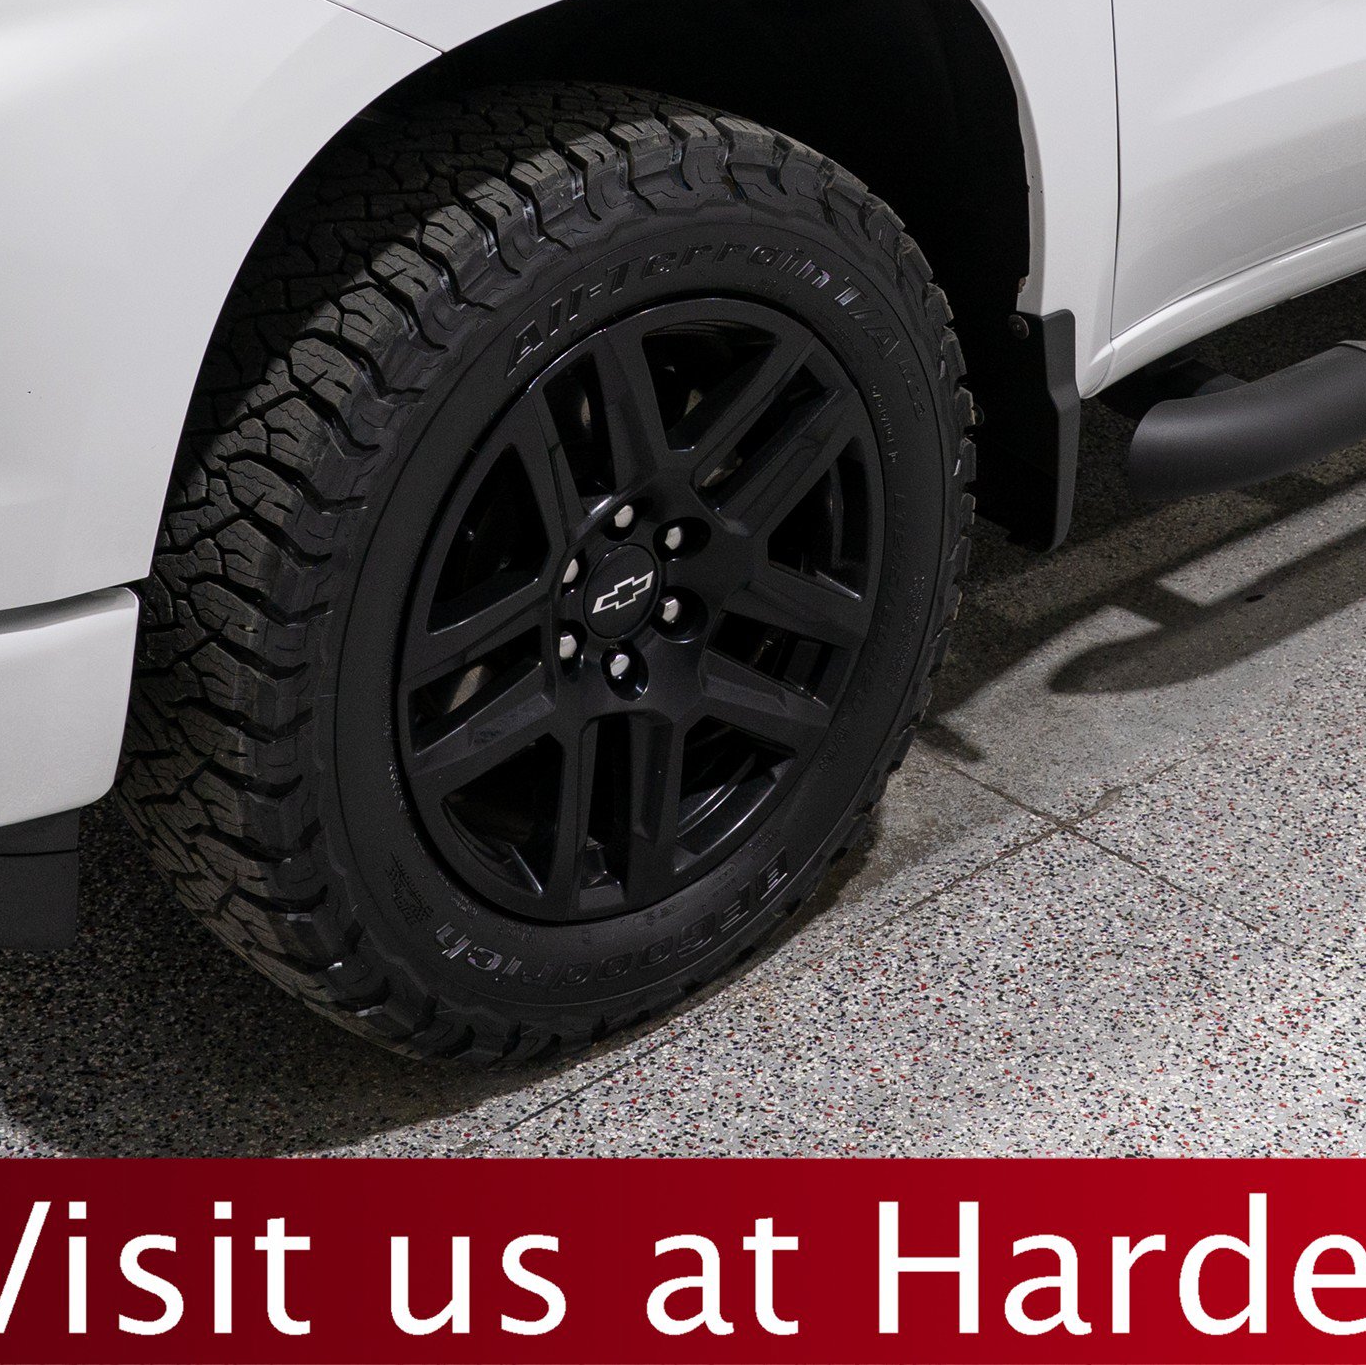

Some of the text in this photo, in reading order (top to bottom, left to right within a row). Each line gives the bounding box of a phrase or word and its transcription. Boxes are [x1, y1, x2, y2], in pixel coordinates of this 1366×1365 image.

[506, 240, 832, 376] All-Terrain
[835, 276, 900, 360] T/A
[436, 846, 788, 992] BFGoodrich
